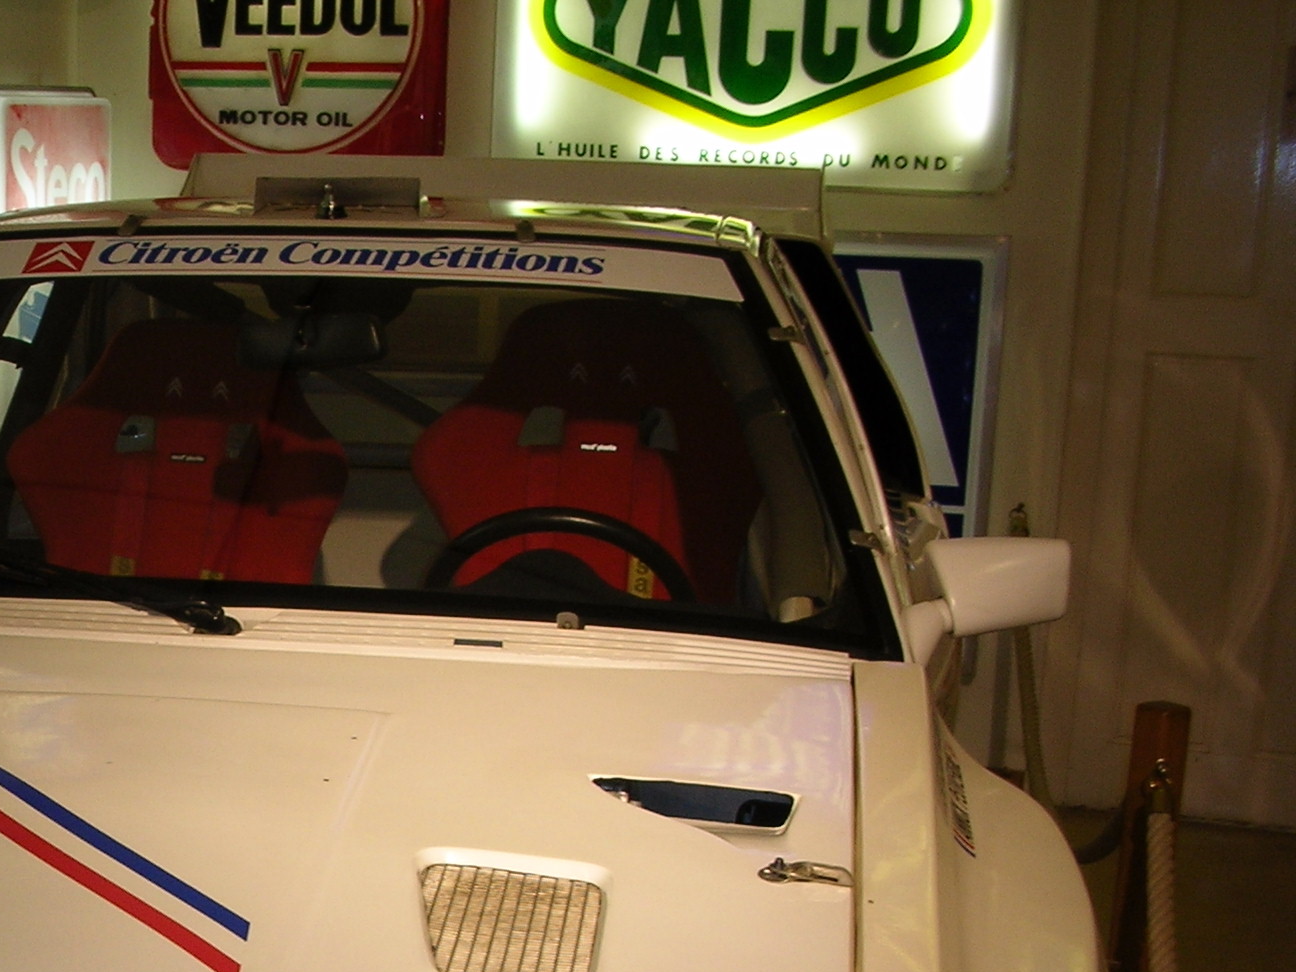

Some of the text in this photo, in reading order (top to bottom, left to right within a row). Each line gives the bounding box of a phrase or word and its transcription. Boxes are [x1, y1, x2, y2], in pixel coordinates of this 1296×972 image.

[218, 110, 353, 128] MOTOR OIL
[639, 145, 680, 163] DES
[699, 149, 799, 167] RECORDS
[823, 153, 851, 168] DU
[98, 241, 606, 276] Citroën Compétitions
